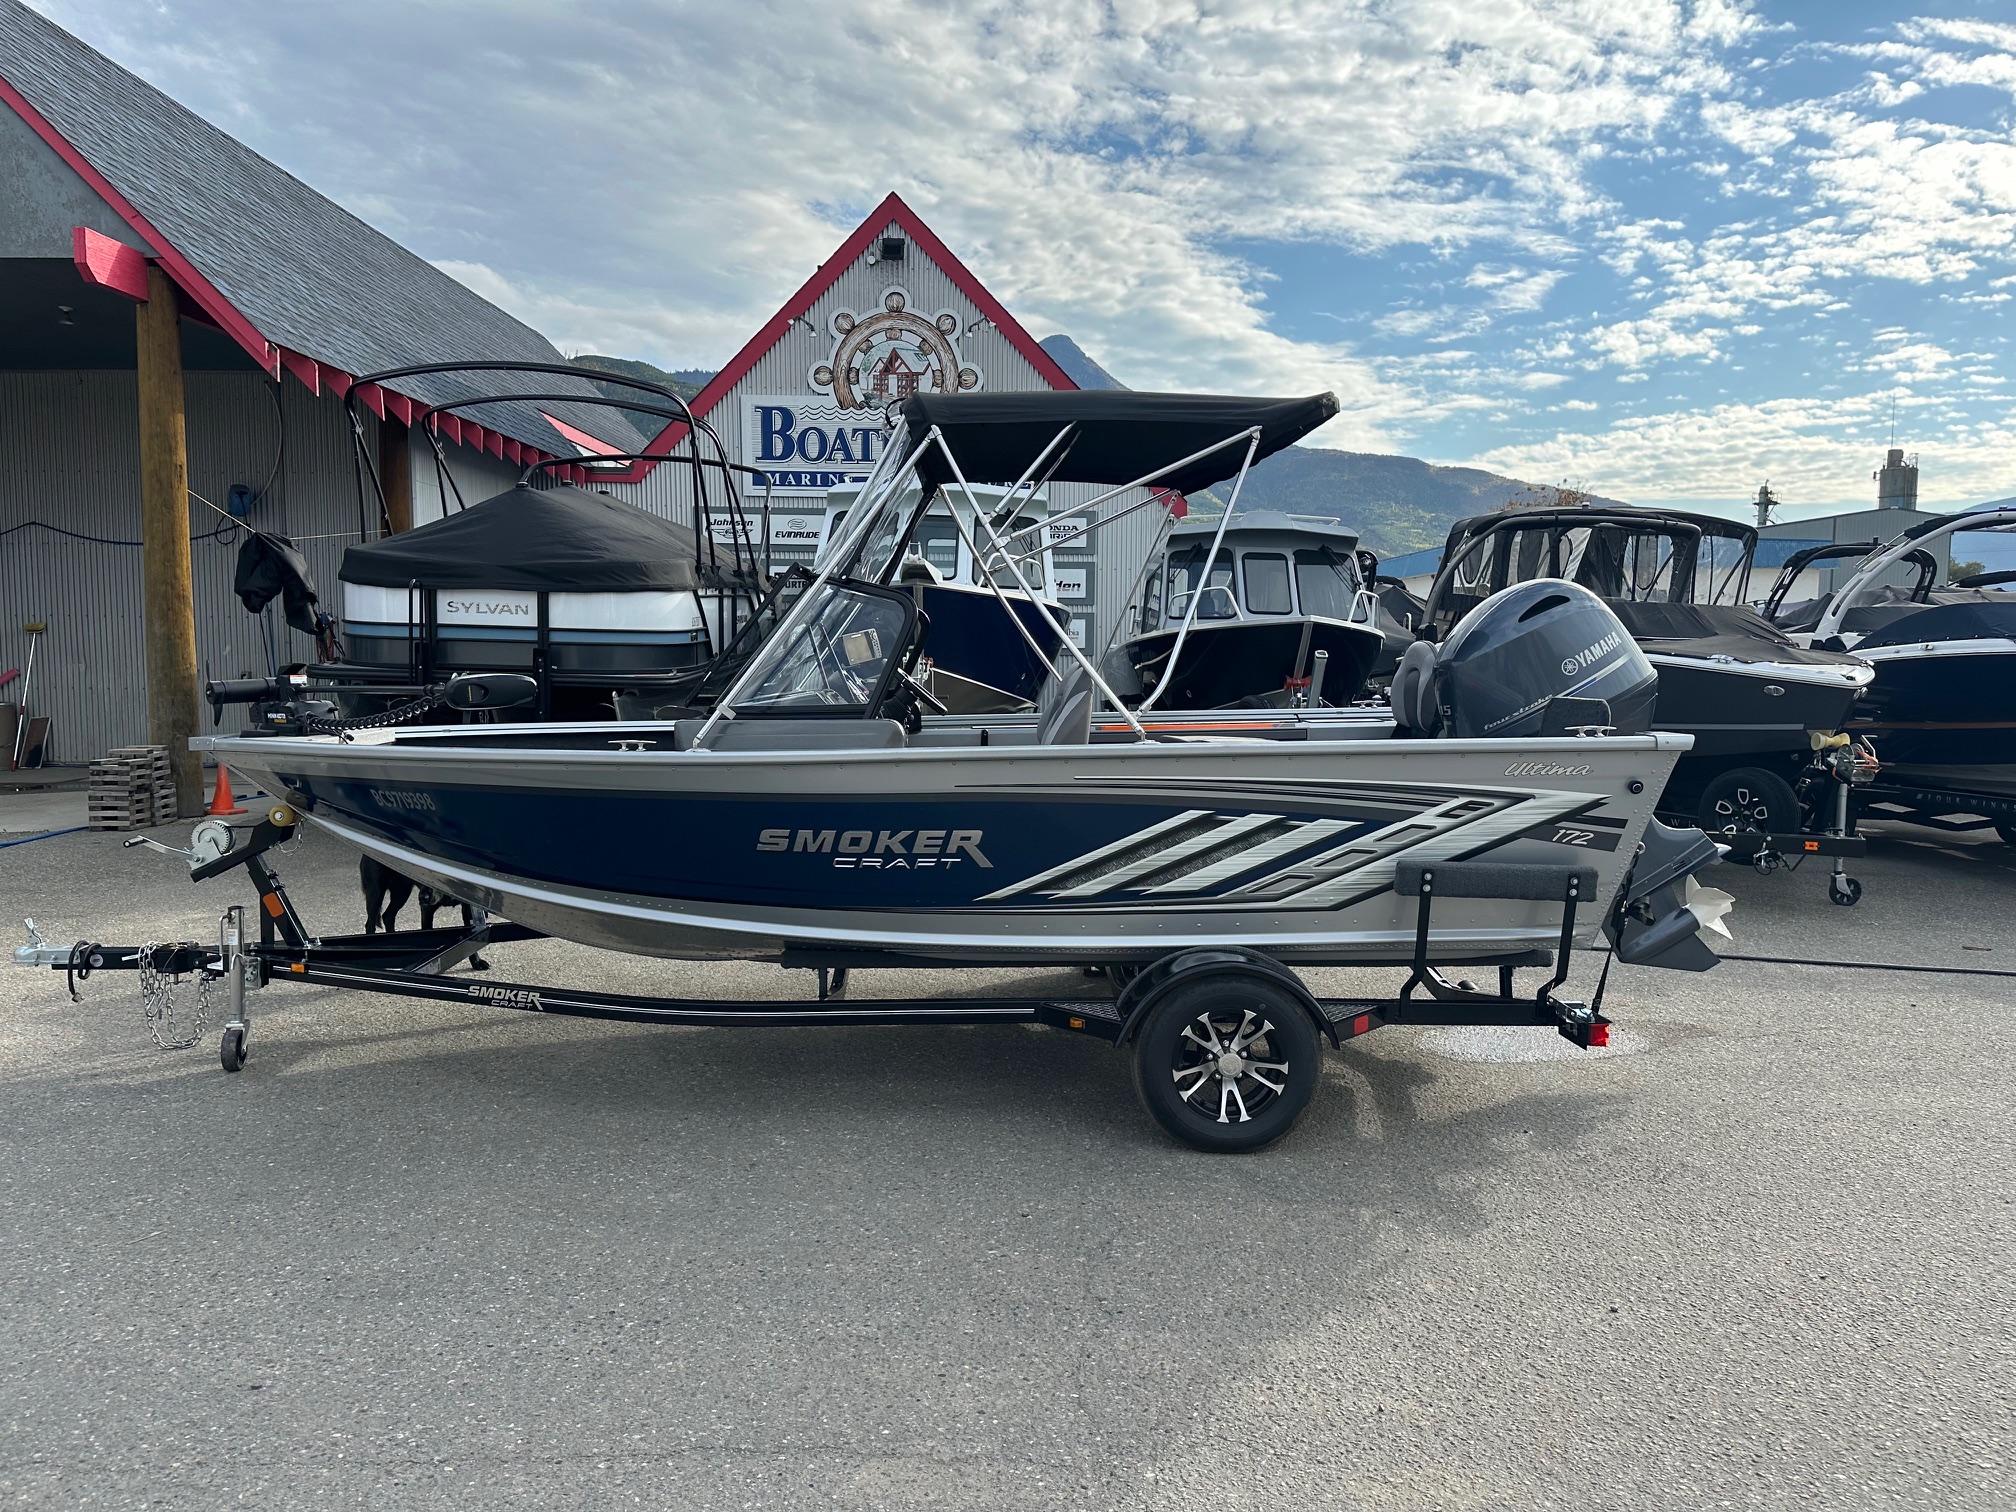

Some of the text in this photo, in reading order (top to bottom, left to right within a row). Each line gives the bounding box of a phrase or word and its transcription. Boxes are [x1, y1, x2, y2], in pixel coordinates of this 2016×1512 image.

[754, 406, 889, 464] BOAT
[447, 600, 529, 615] SYLVAN
[1575, 631, 1622, 668] YAMAHA
[1504, 762, 1594, 776] Ultima
[1552, 829, 1595, 845] 172
[756, 829, 994, 868] SMOKER
[832, 857, 962, 869] CRAFT
[467, 985, 543, 1011] SMOKER
[491, 1000, 534, 1009] CRAFT
